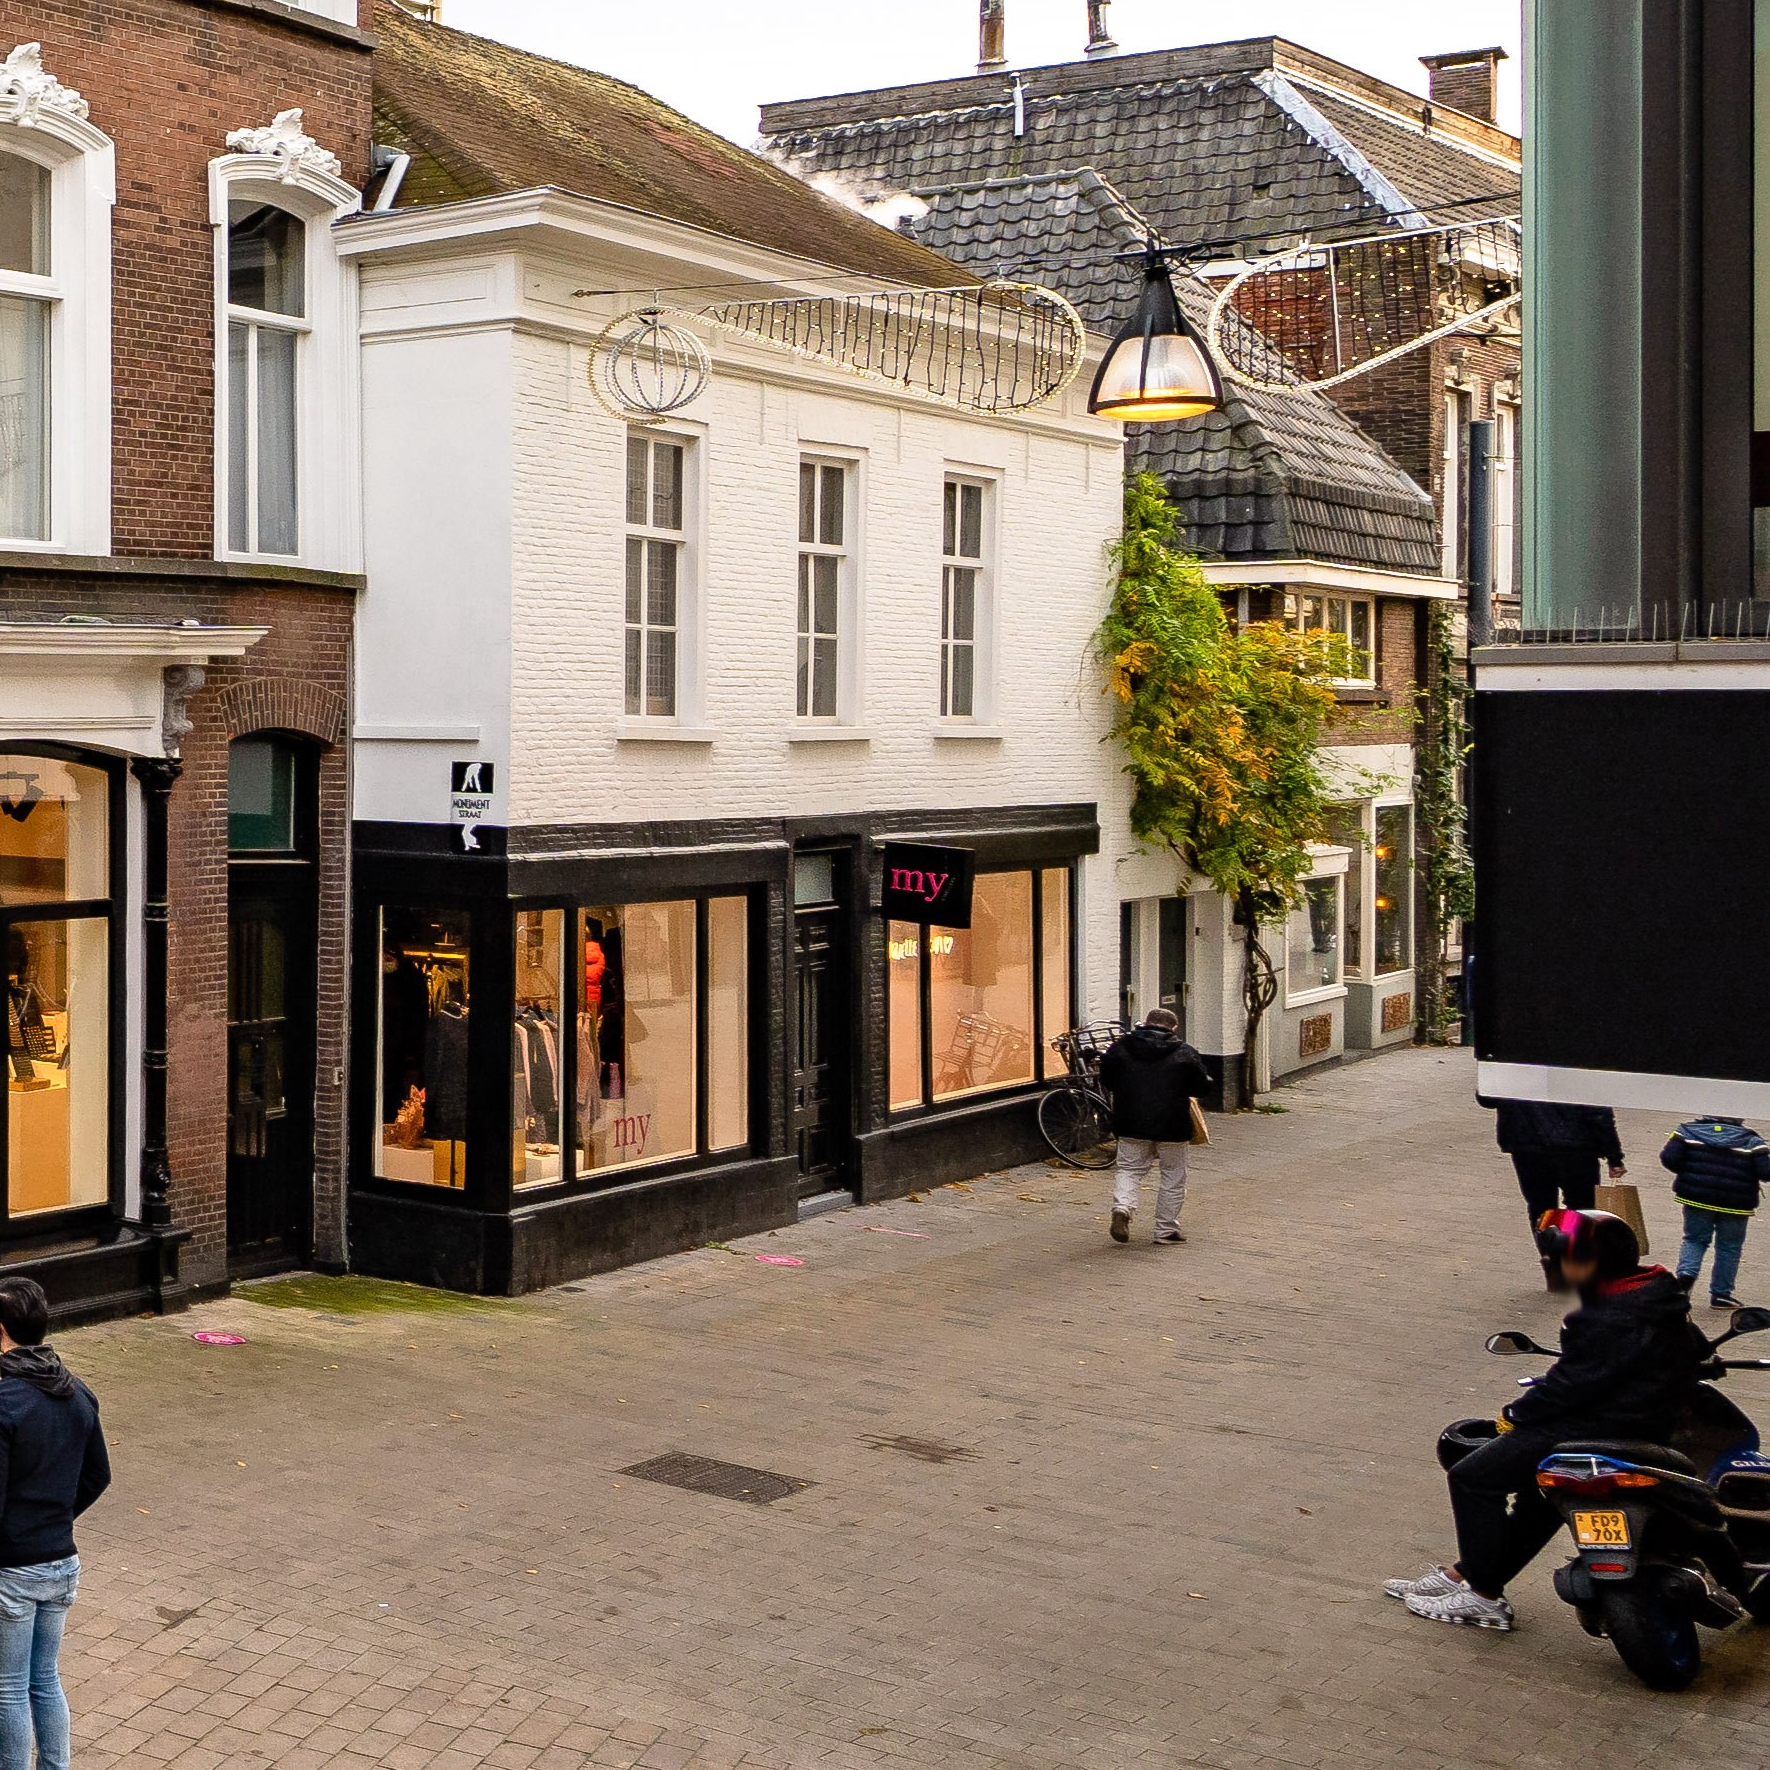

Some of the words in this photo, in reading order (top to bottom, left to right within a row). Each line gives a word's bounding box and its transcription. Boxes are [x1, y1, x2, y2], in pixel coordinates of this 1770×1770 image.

[453, 798, 491, 810] MONUMENT
[458, 810, 482, 818] STRAAT
[890, 868, 949, 902] my
[613, 1113, 651, 1155] my
[1591, 1514, 1620, 1528] FD9
[1592, 1528, 1624, 1541] 70X
